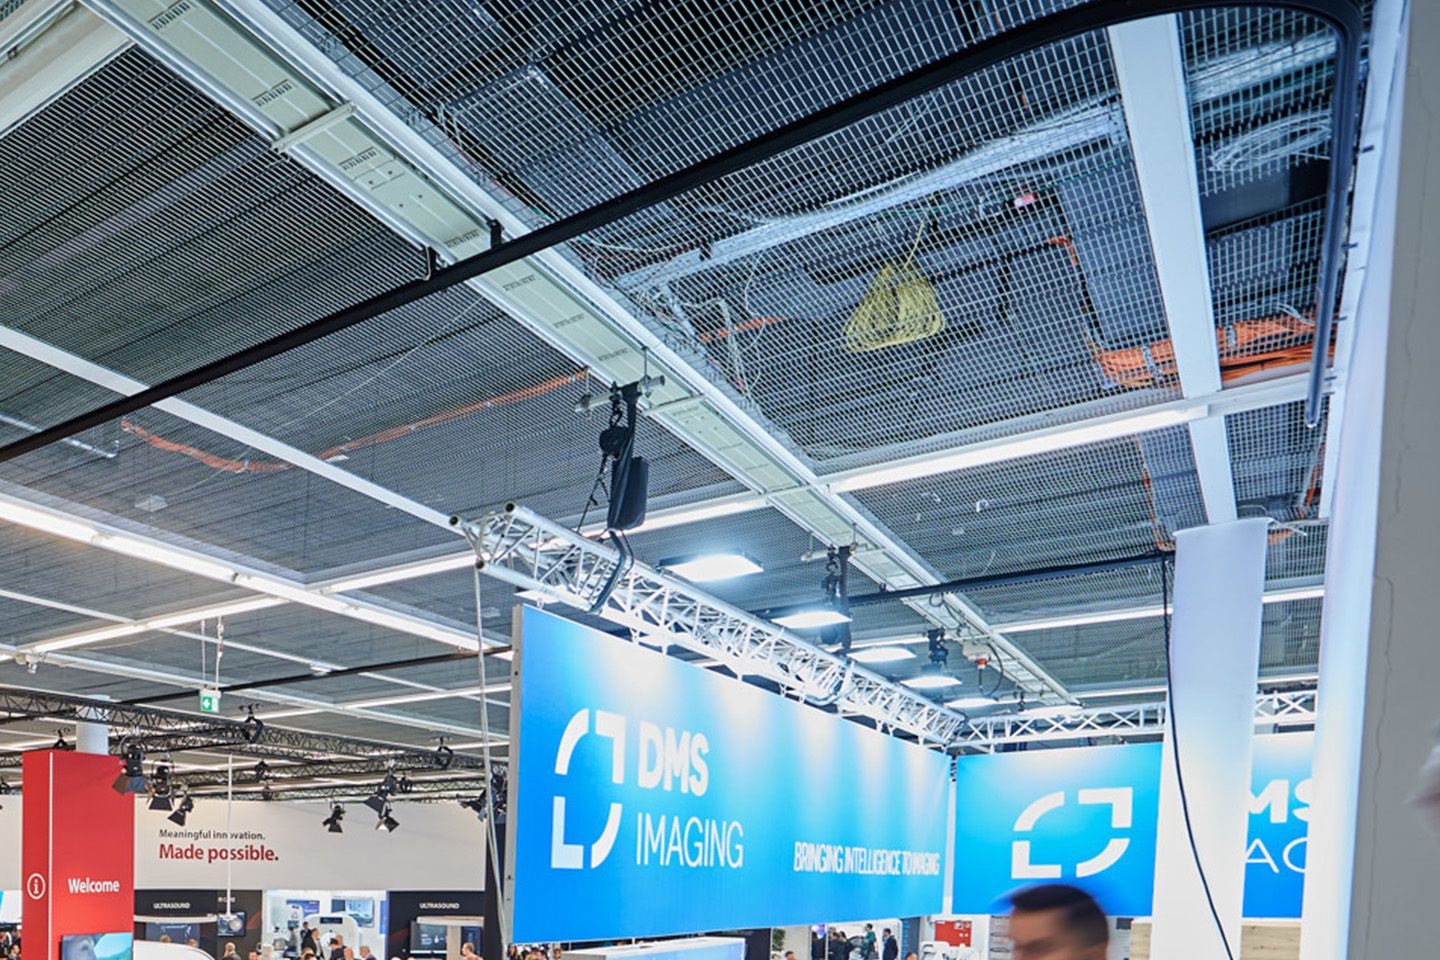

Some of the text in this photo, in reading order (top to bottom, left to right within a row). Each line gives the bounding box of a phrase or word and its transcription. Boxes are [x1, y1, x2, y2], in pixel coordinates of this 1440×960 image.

[637, 720, 709, 797] DMS
[159, 829, 266, 841] Meaningful innvation.
[636, 811, 744, 869] IMAGING
[159, 843, 279, 864] Made possible.
[793, 841, 844, 874] BRINGING
[844, 846, 901, 876] INTELLIGENCE
[67, 877, 119, 894] Welcome
[153, 902, 191, 910] ULTRASOUND
